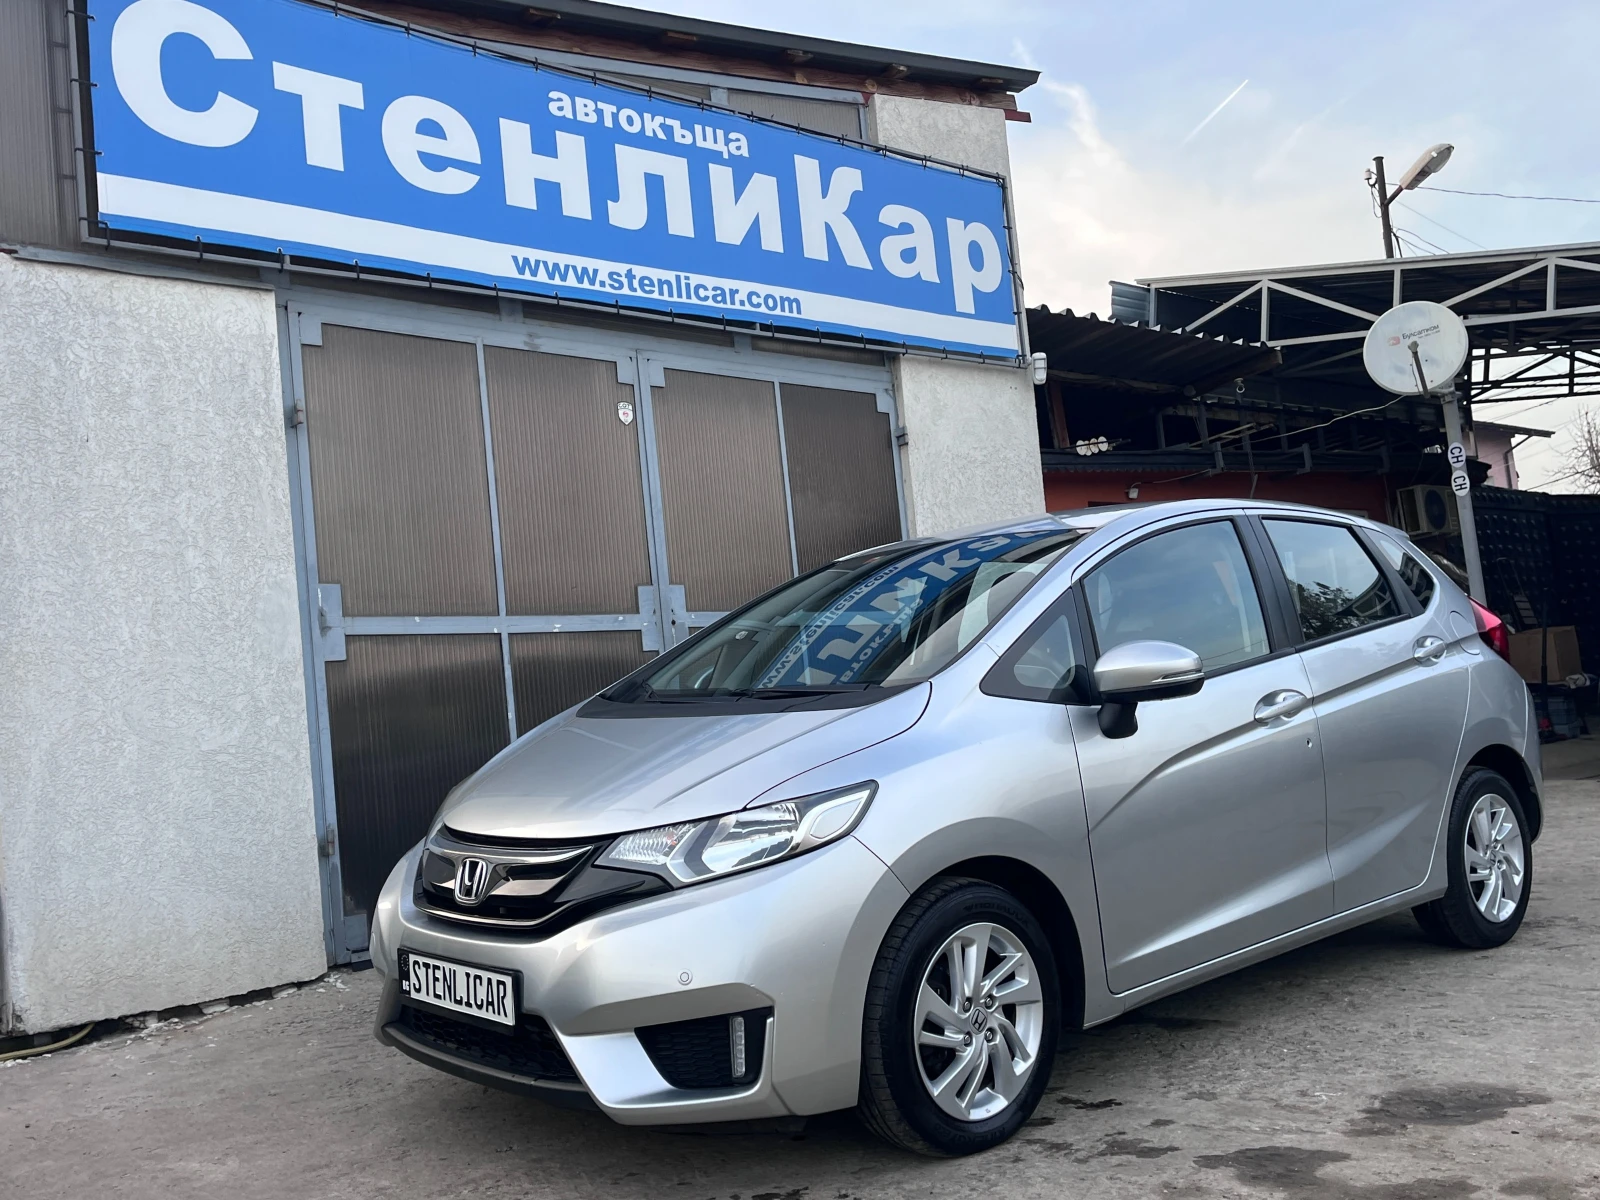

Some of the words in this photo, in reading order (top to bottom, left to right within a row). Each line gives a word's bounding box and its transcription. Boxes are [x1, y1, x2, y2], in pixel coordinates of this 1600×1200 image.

[548, 90, 749, 158] автокъща
[110, 0, 1002, 314] СтенлиКар
[511, 254, 802, 316] www.stenlicar.com
[1450, 446, 1464, 464] CH
[1453, 475, 1468, 491] CH
[412, 959, 508, 1018] STENLICAR
